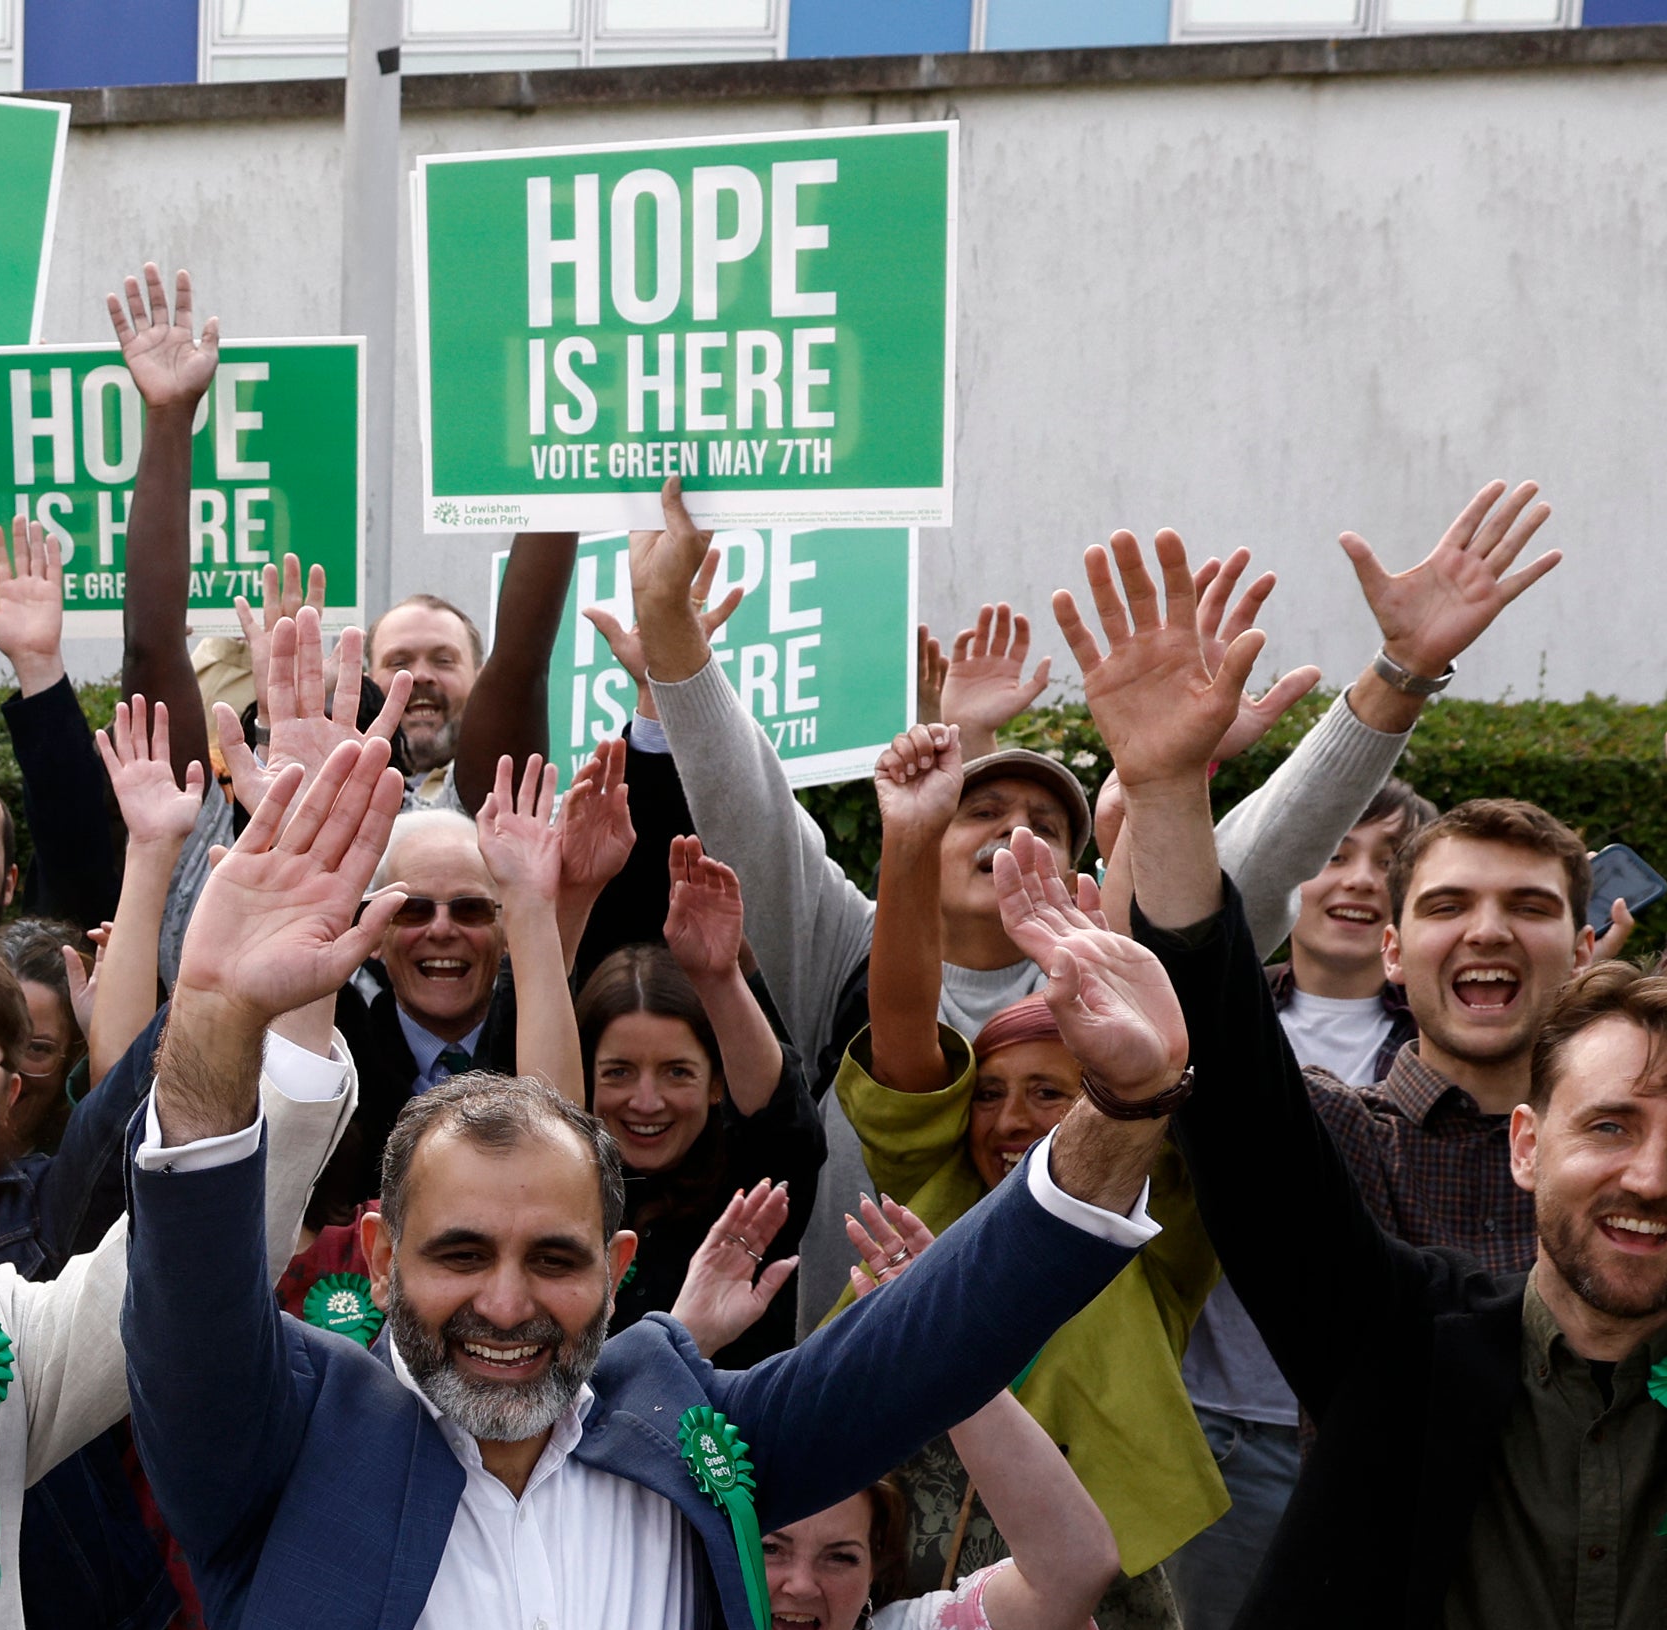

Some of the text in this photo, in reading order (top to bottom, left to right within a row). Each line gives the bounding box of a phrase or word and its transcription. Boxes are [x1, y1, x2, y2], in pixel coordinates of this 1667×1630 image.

[526, 159, 838, 328] HOPE
[528, 327, 836, 436] IS HERE
[10, 362, 270, 486] HOE
[531, 438, 832, 481] VOTE GREEN MAY 7TH
[98, 487, 270, 565] HRE
[464, 502, 522, 516] Lewisham
[464, 514, 531, 528] Green Party
[85, 572, 126, 600] GRE
[188, 571, 217, 598] AY
[223, 570, 266, 598] 7TH
[575, 528, 822, 668] HPE
[714, 632, 821, 718] RE
[571, 668, 629, 748] IS
[773, 716, 817, 750] 7TH
[704, 1454, 727, 1467] Green
[710, 1466, 732, 1478] Party
